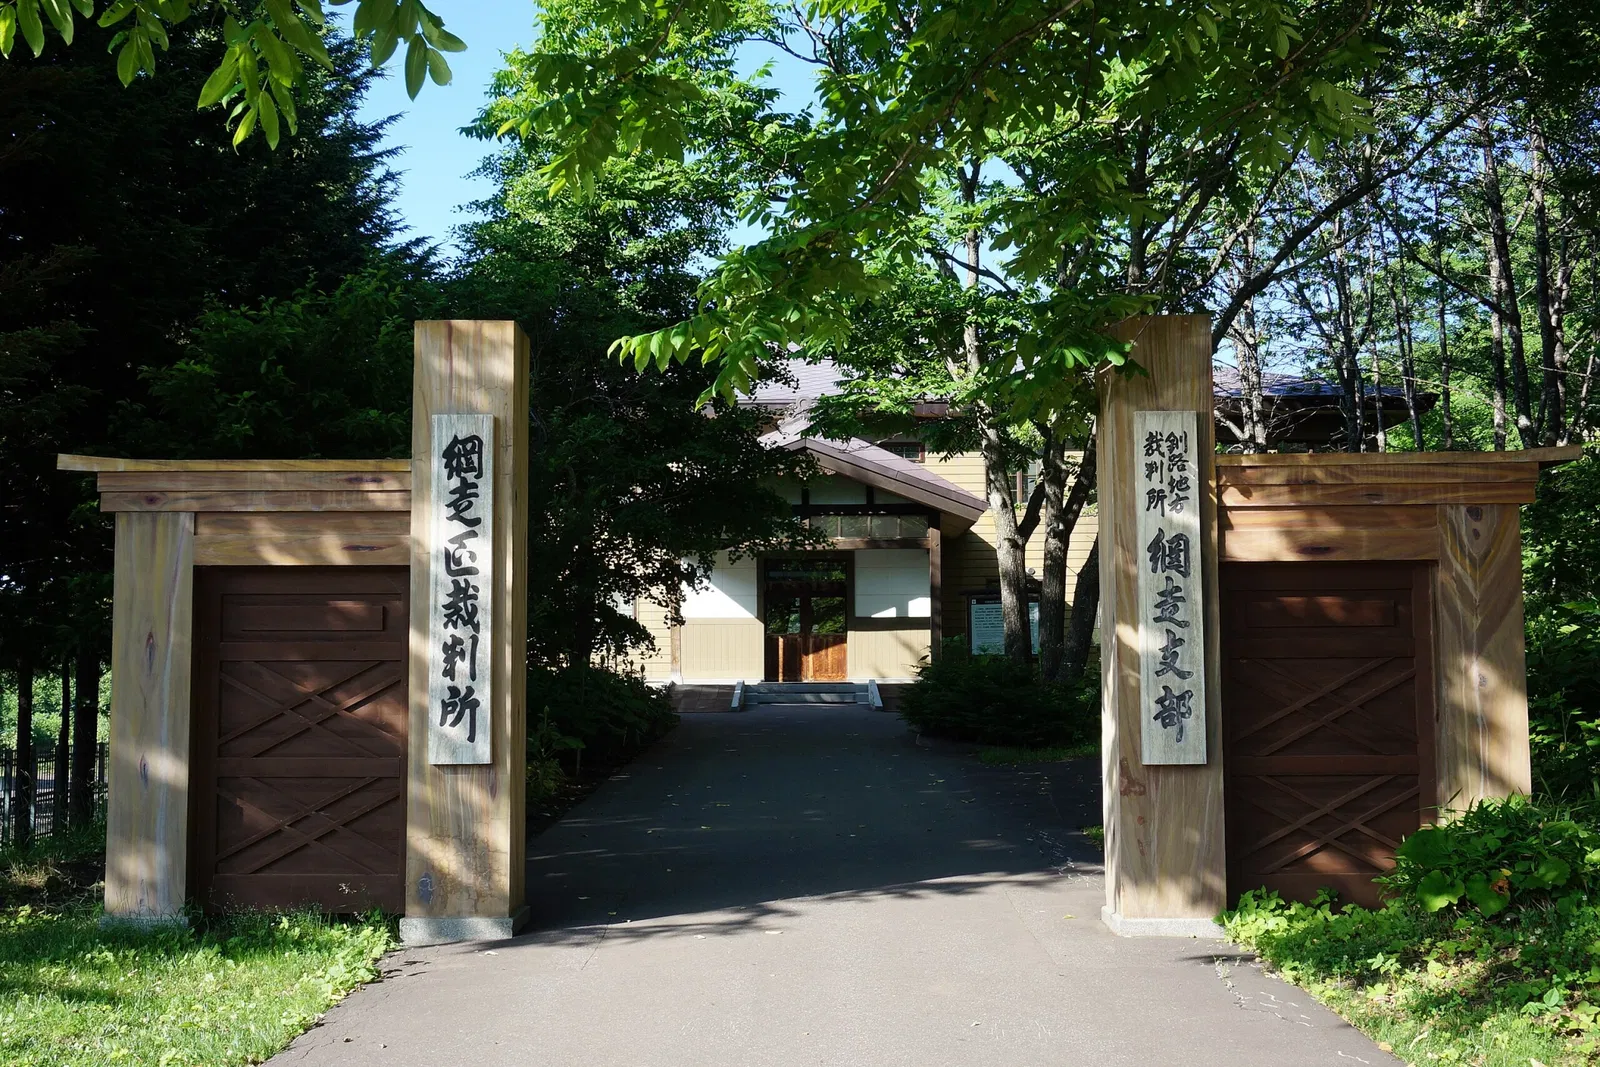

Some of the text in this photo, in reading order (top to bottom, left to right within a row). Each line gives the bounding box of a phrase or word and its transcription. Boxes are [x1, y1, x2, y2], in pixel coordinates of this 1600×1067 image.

[1143, 430, 1167, 518] 裁判所
[1146, 527, 1195, 743] 網走支部
